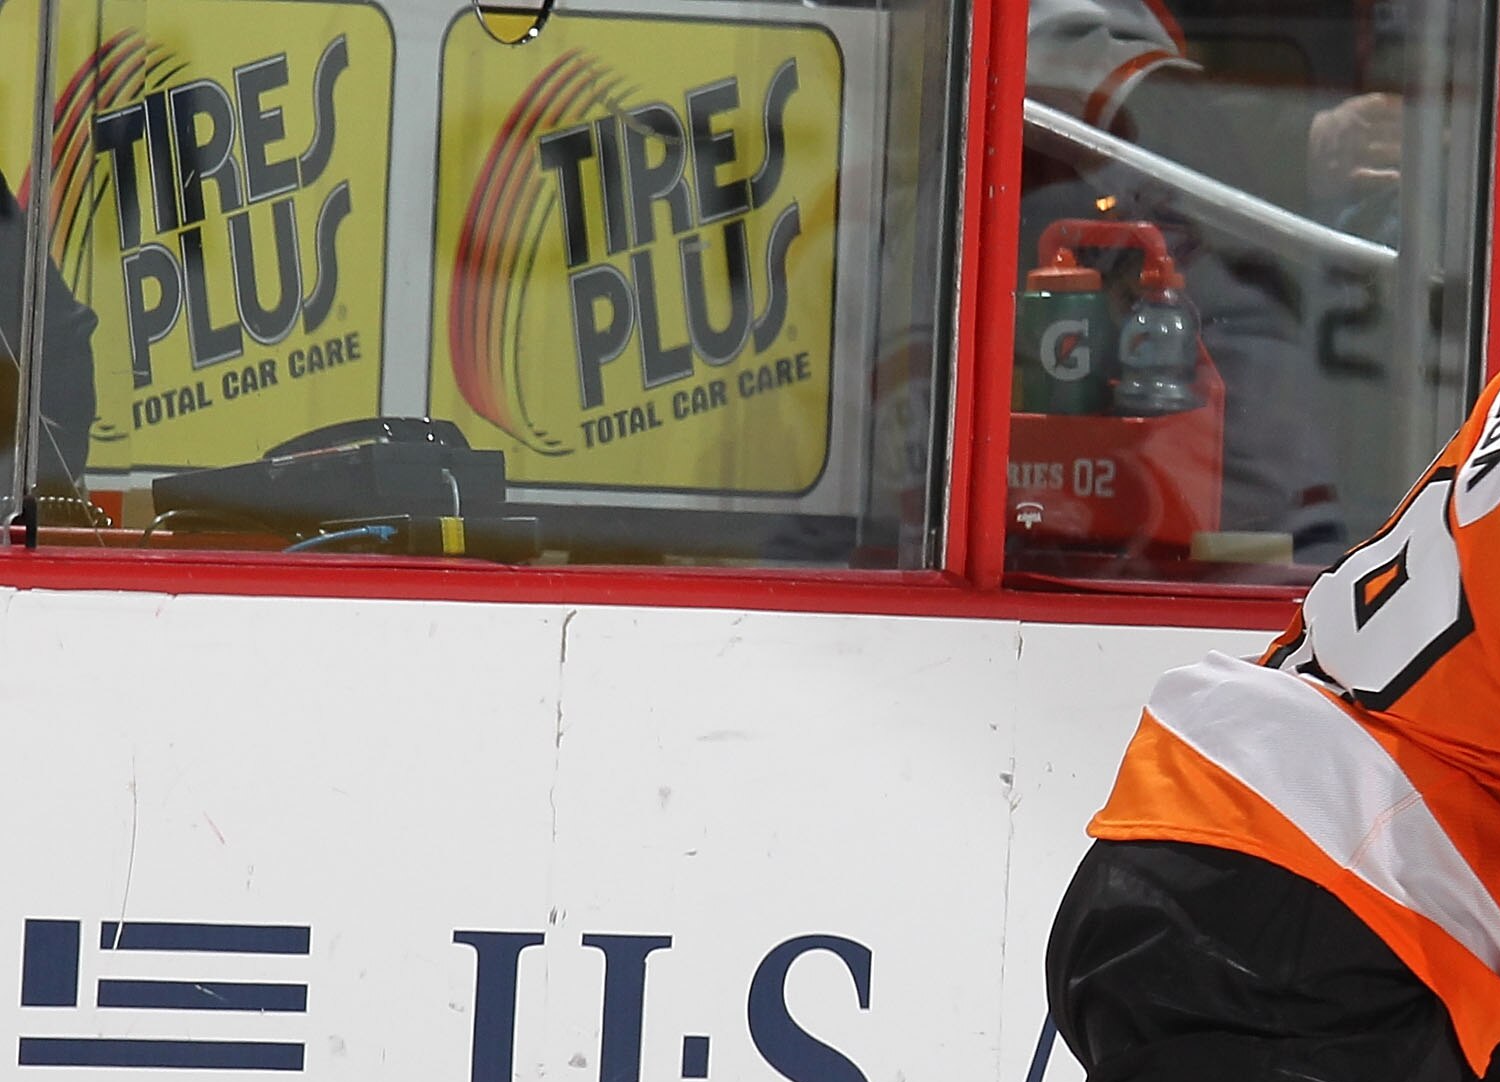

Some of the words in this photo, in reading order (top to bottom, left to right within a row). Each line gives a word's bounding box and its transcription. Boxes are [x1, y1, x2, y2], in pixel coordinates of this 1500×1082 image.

[91, 32, 349, 251] TIRES
[539, 57, 799, 269] TIRES
[121, 179, 351, 390] PLUS
[569, 201, 801, 411] PLUS
[1040, 319, 1091, 381] G
[132, 382, 213, 430] TOTAL
[222, 359, 278, 400] CAR
[289, 332, 361, 379] CARE
[581, 402, 663, 449] TOTAL
[672, 380, 728, 420] CAR
[738, 353, 811, 398] CARE
[1073, 458, 1116, 497] 02
